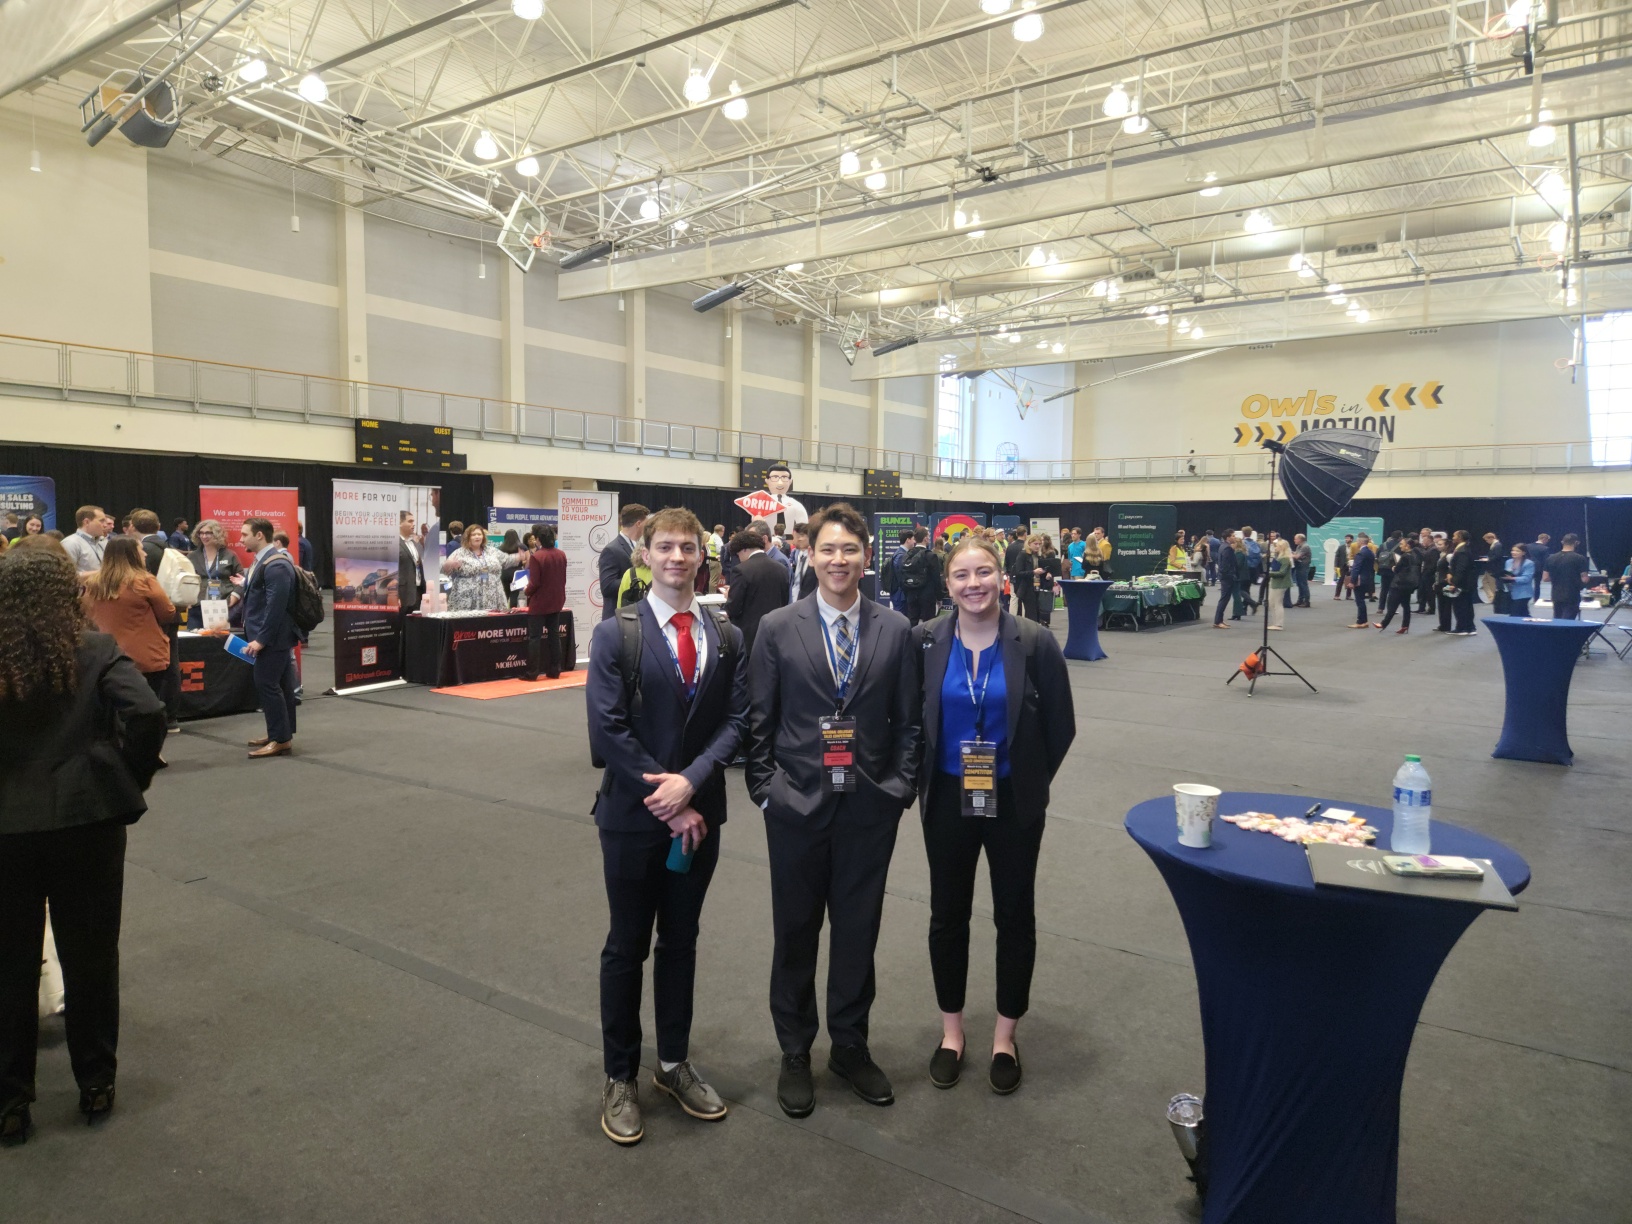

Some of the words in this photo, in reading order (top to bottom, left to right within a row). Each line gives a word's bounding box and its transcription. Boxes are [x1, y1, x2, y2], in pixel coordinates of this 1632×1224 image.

[1241, 390, 1337, 419] Owls
[1340, 403, 1363, 414] in
[361, 420, 379, 428] HOME
[434, 427, 452, 435] GUEST
[334, 492, 359, 500] MORE
[362, 492, 378, 501] FOR
[381, 494, 397, 502] YOU
[742, 498, 778, 511] ORKIN
[335, 516, 397, 526] WORRY-FREE!
[452, 631, 477, 650] grow
[478, 629, 503, 639] MORE
[505, 628, 527, 637] WITH
[496, 660, 527, 669] MOHAWK
